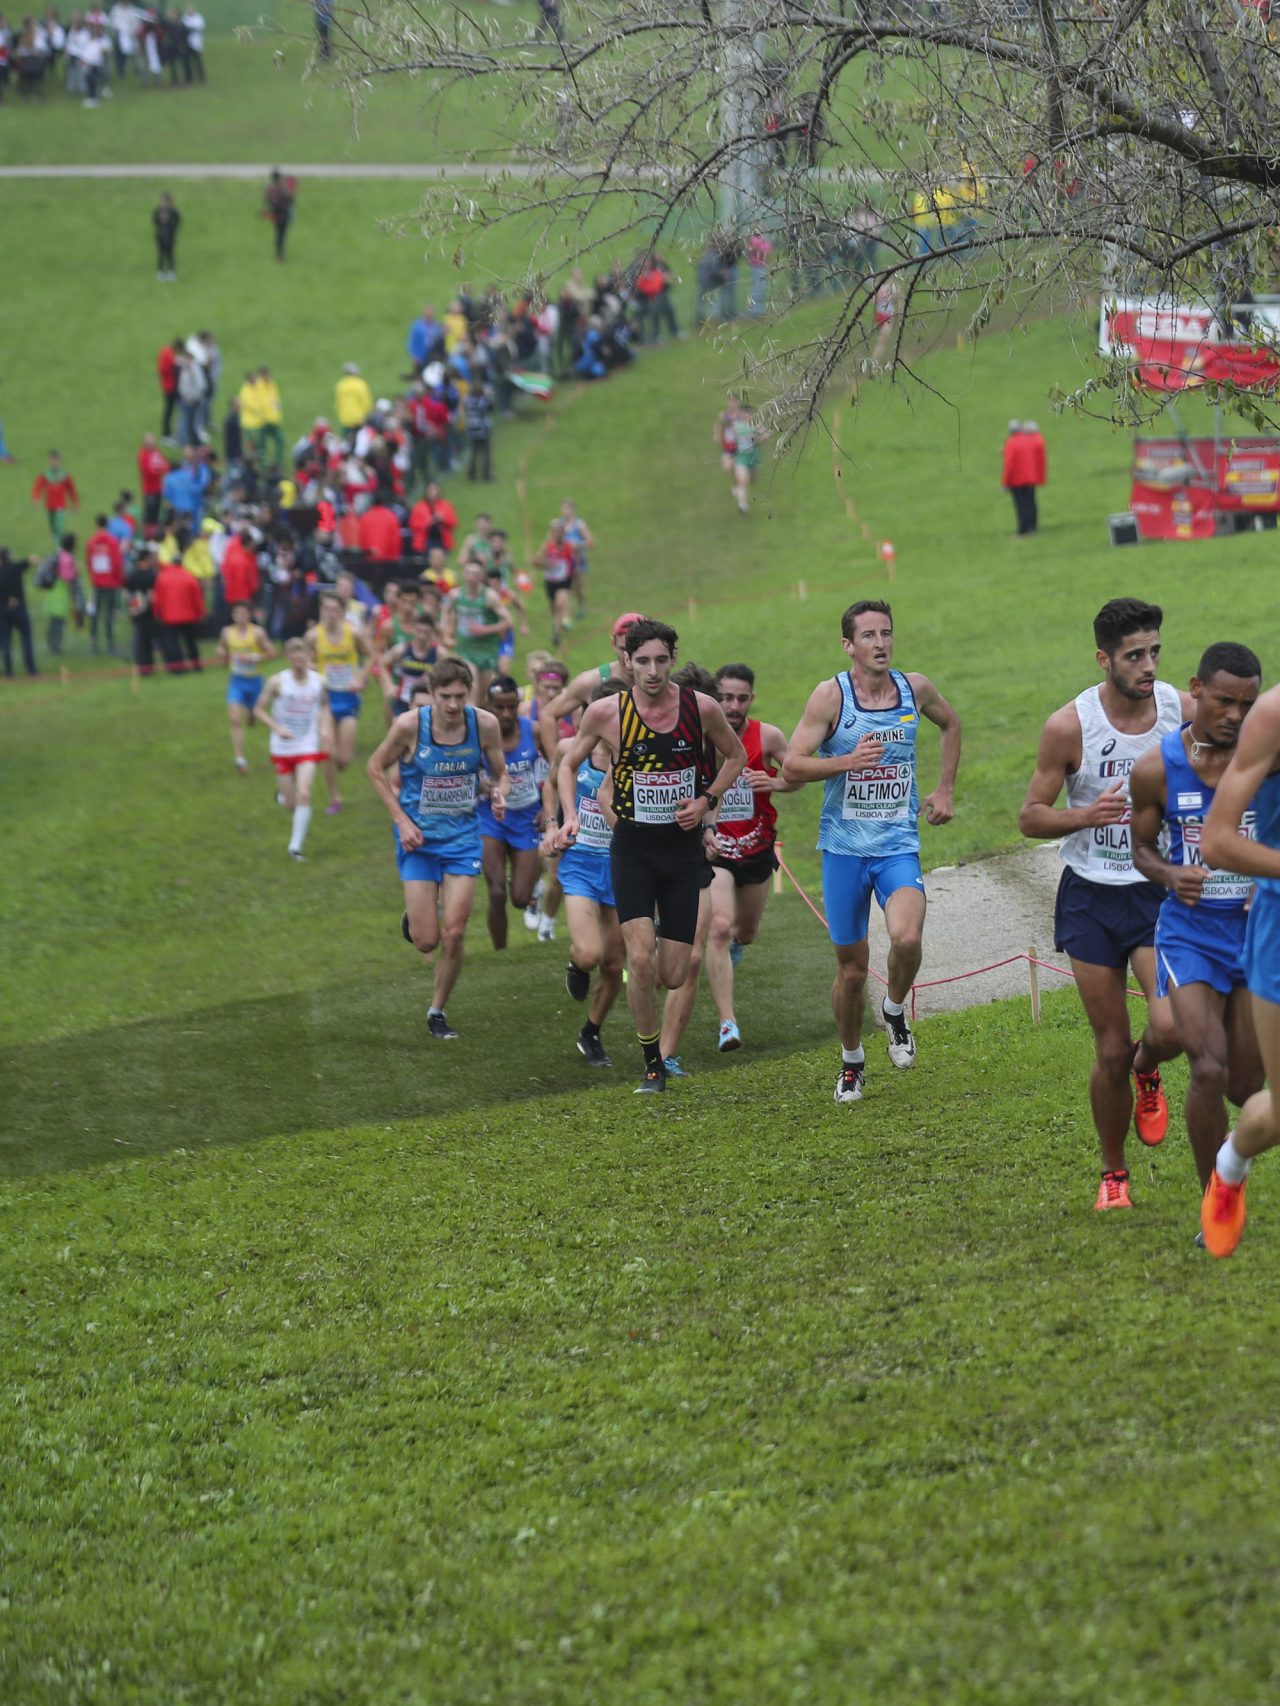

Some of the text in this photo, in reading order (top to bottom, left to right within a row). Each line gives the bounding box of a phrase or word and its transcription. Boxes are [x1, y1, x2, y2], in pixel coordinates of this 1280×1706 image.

[862, 728, 905, 744] RAINE
[434, 760, 465, 772] ITALIA
[635, 773, 681, 785] SPAR
[850, 768, 897, 780] SPAR
[424, 778, 463, 788] SPAR
[636, 783, 693, 805] GRIMARD
[847, 780, 910, 801] ALFIMOV
[855, 810, 883, 818] LISBOA
[1093, 825, 1130, 850] GILA
